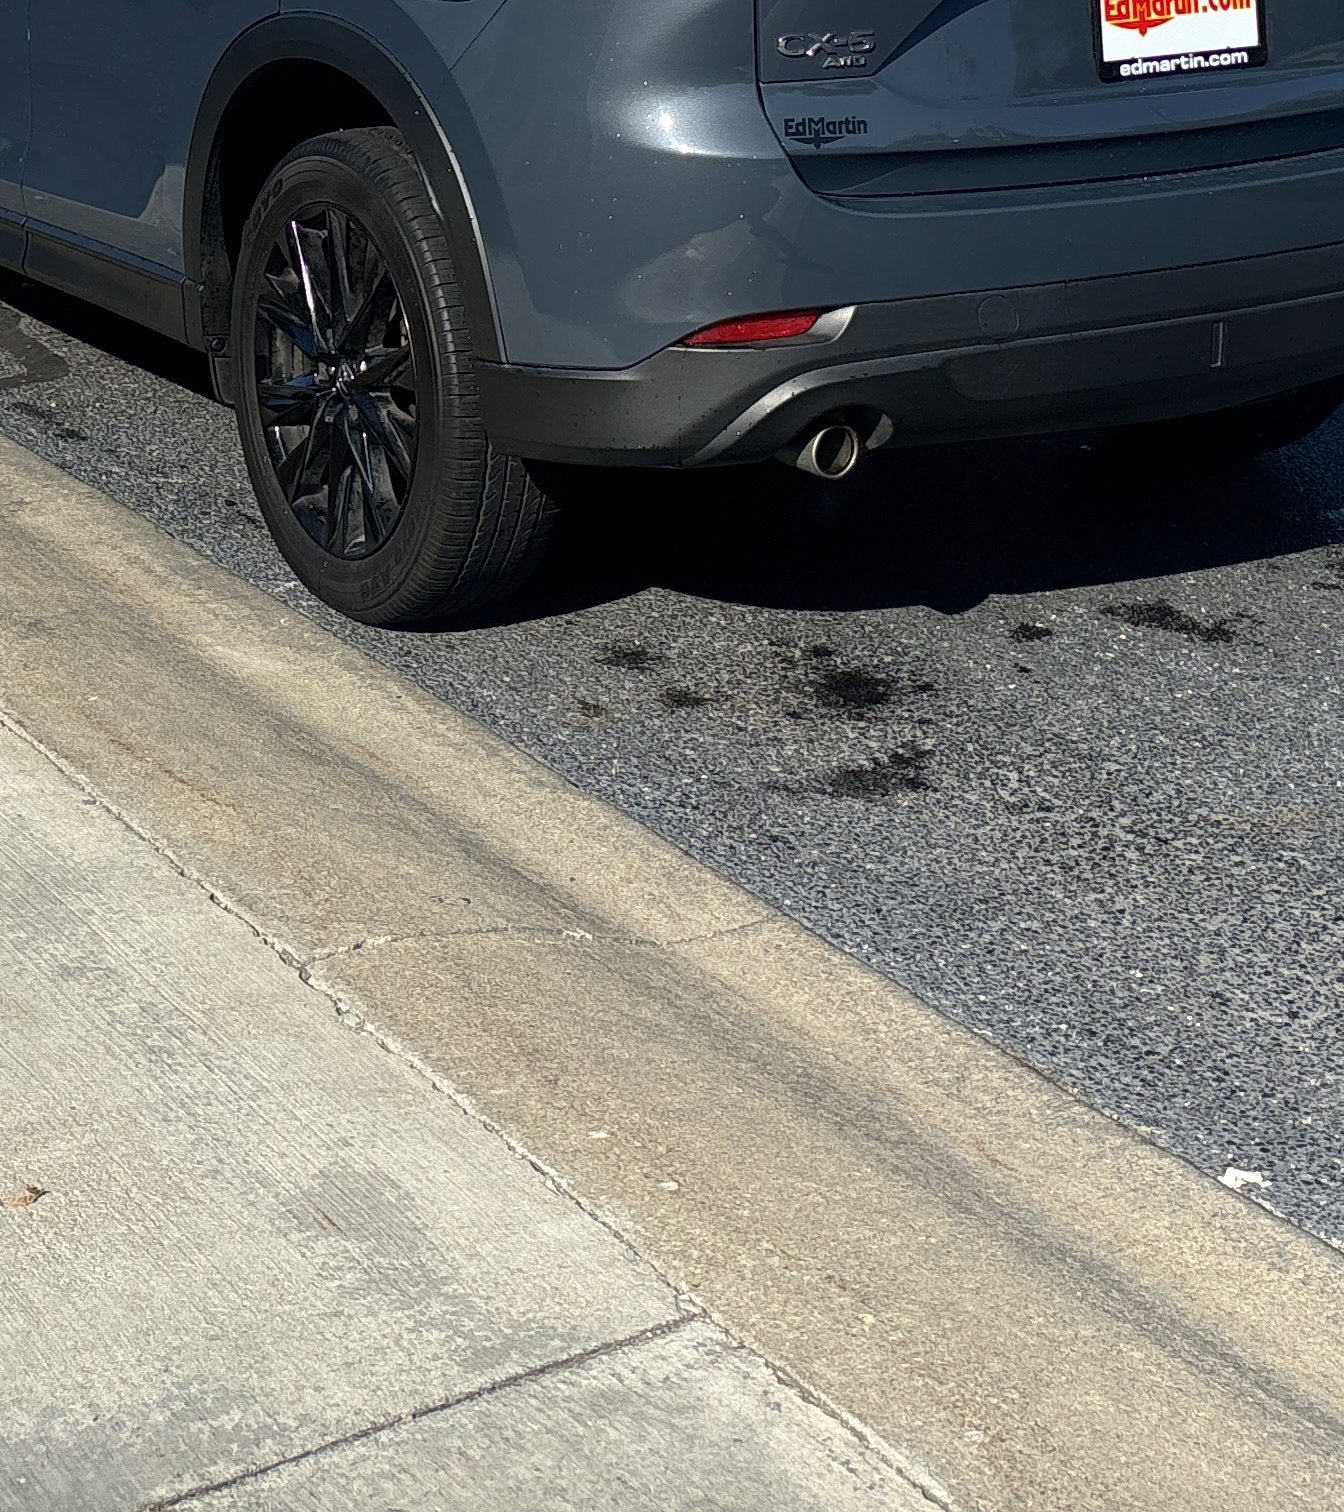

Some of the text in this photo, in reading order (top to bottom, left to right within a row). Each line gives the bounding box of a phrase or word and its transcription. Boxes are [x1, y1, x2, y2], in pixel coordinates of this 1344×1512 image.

[777, 31, 876, 57] CX-5
[1119, 51, 1249, 77] edmartin.com
[783, 115, 868, 138] EdMartin
